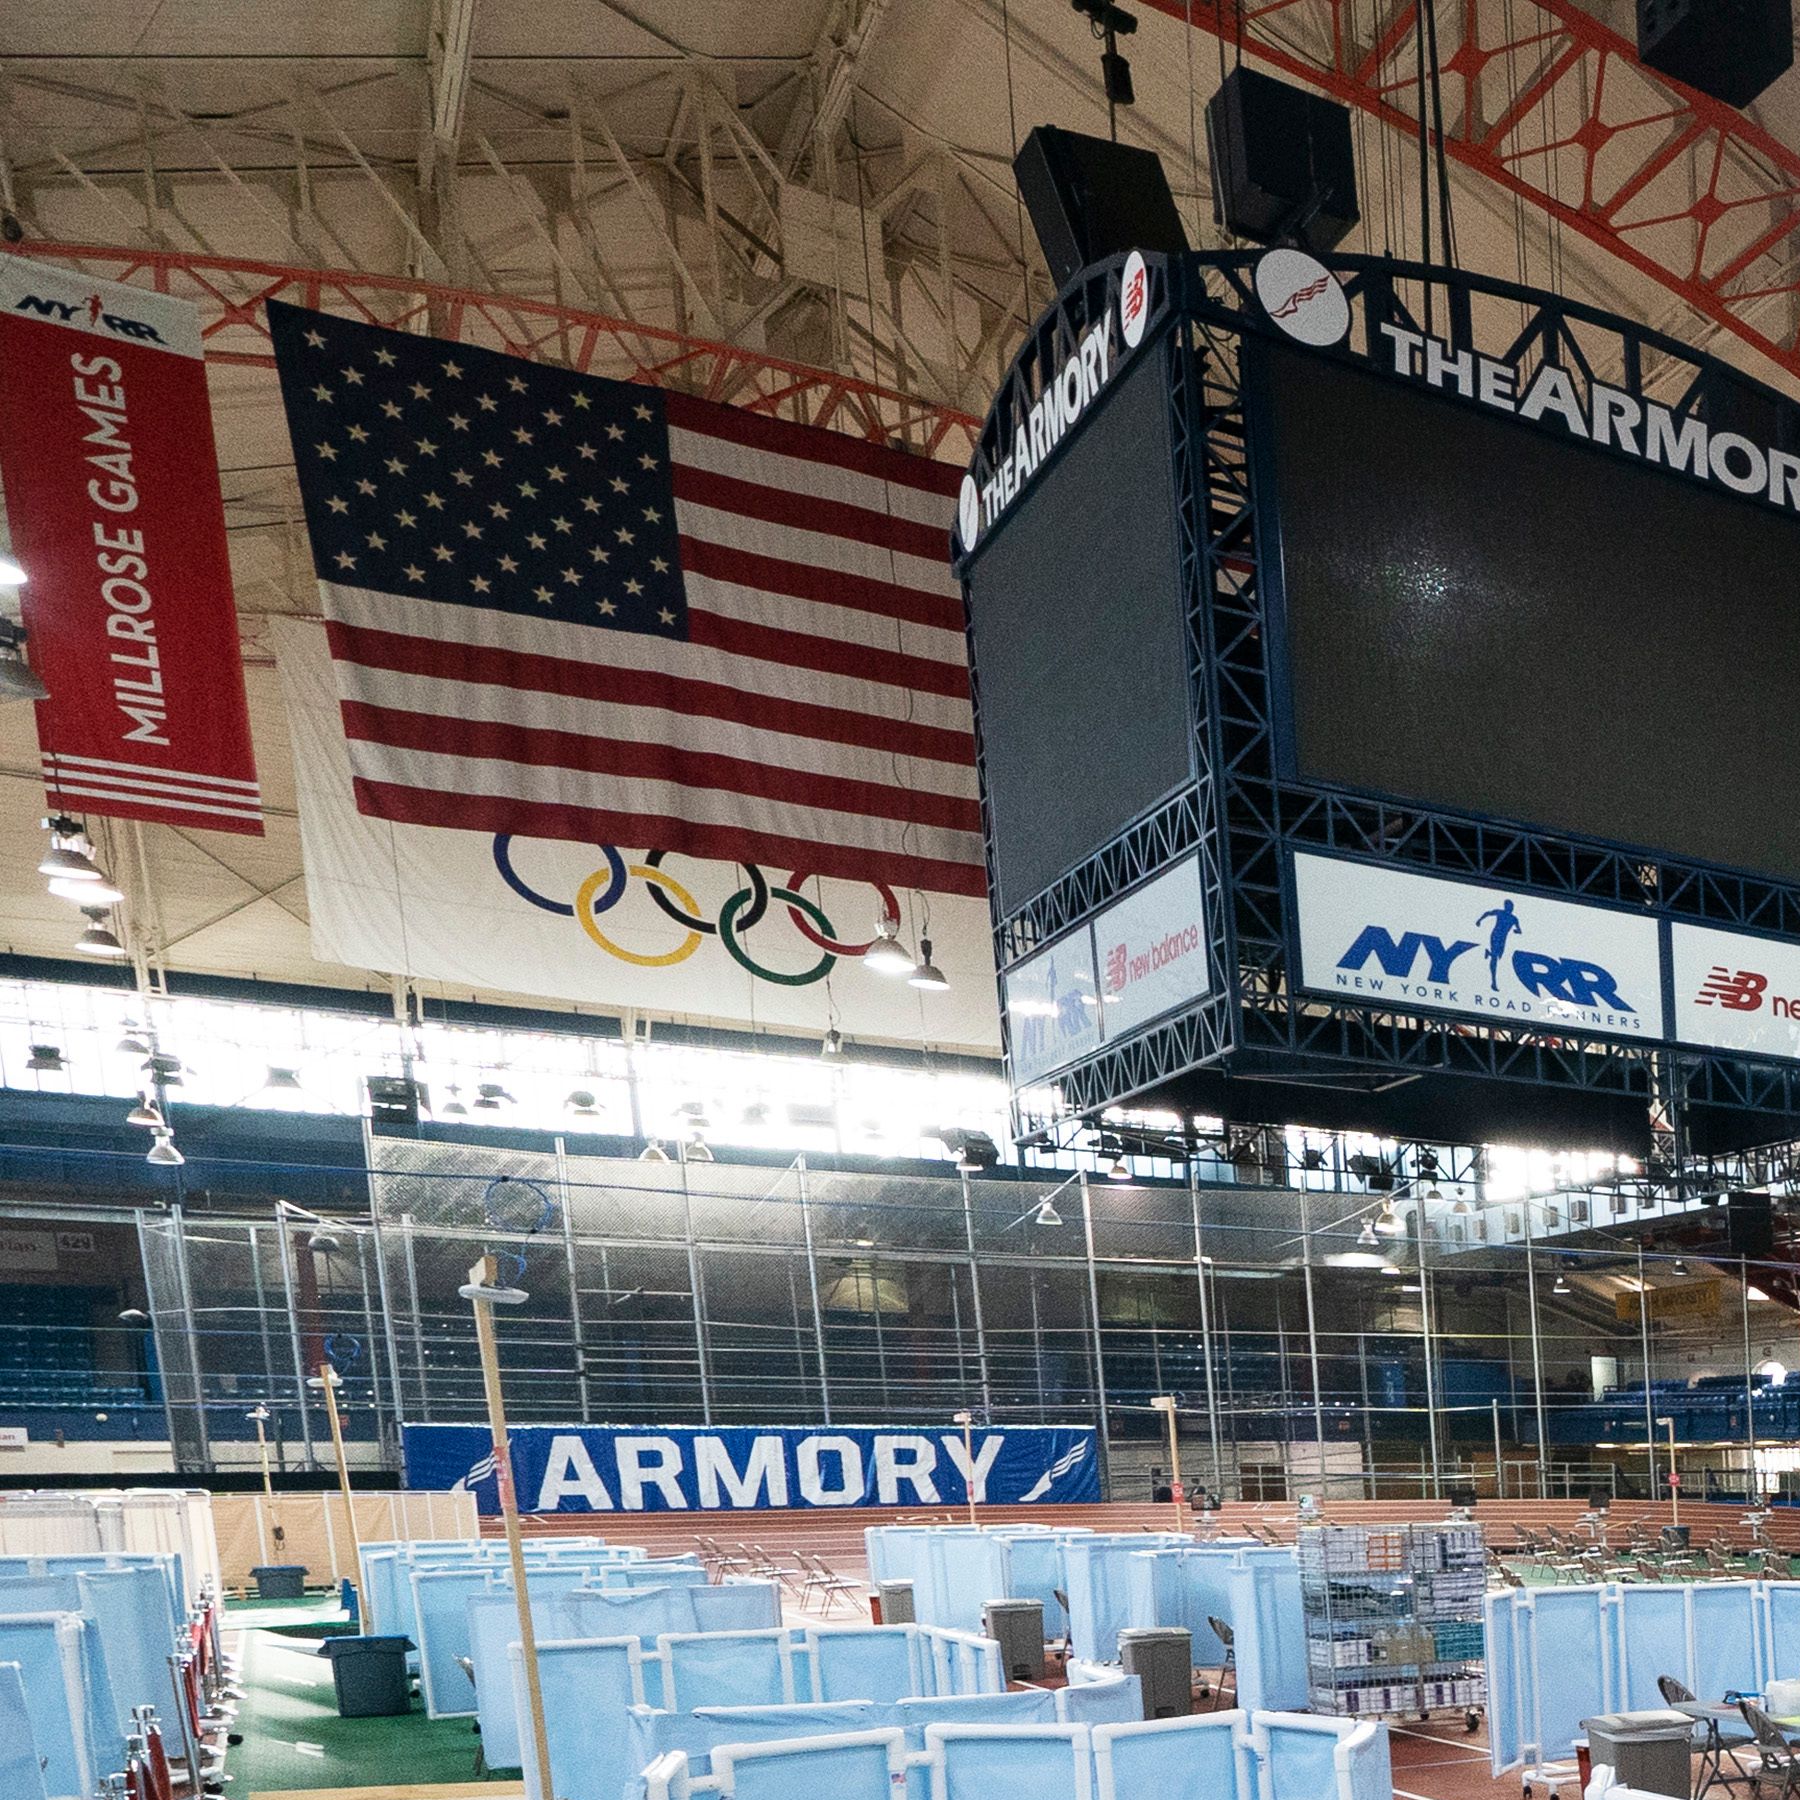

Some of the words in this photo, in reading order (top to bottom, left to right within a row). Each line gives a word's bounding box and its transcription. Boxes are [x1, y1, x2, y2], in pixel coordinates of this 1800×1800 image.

[71, 351, 139, 514] GAMES
[93, 521, 172, 748] MILLROSE
[1150, 923, 1199, 971] balance
[1336, 974, 1384, 993] NEW
[1400, 982, 1460, 1002] YORK
[1475, 994, 1533, 1014] ROAD
[532, 1435, 1005, 1511] ARMORY
